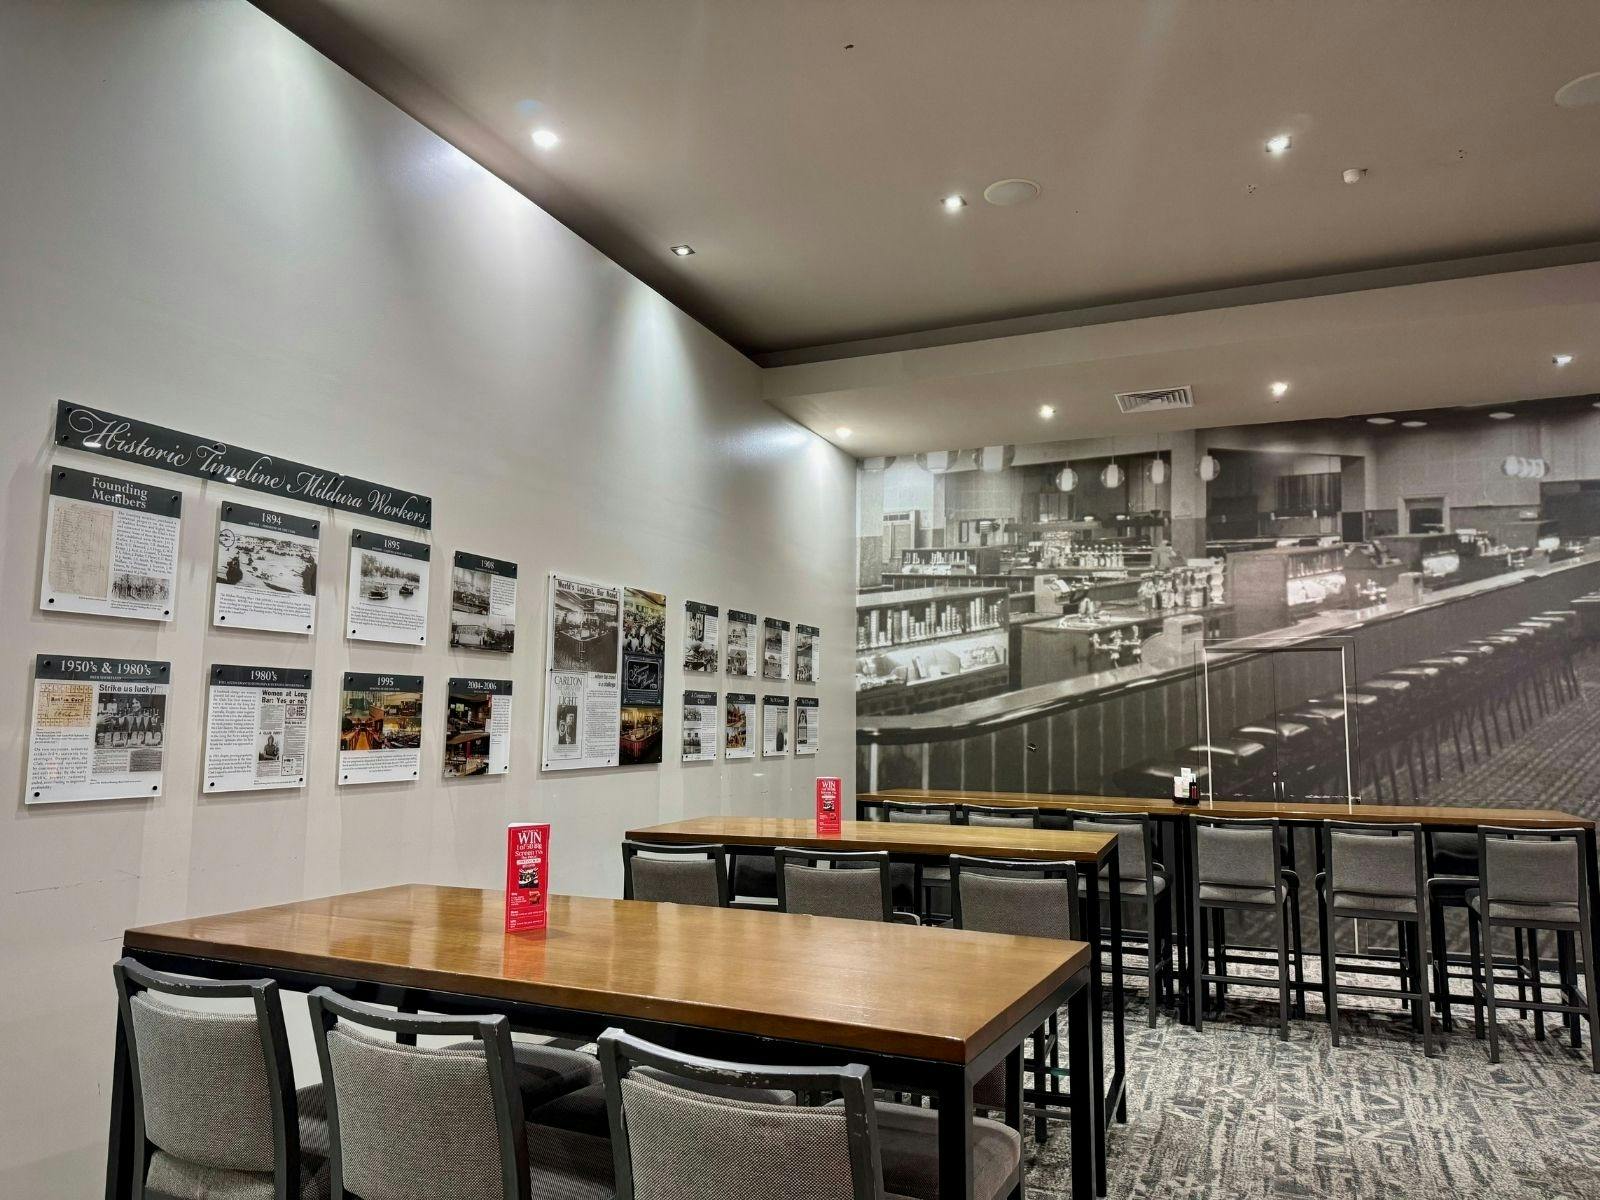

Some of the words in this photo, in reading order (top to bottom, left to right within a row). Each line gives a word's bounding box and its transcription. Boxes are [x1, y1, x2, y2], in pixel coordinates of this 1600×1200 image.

[69, 409, 192, 466] Historic
[196, 443, 285, 488] Timeline
[287, 472, 362, 508] Mildura
[92, 477, 148, 501] Founding
[92, 489, 147, 508] Members
[262, 512, 282, 525] 1894
[384, 540, 400, 550] 1895
[60, 660, 97, 672] 1950's
[102, 662, 112, 674] &
[117, 663, 151, 676] 1980's
[250, 670, 278, 681] 1980's
[377, 676, 394, 686] 1995
[554, 676, 582, 686] CARLTON
[99, 684, 122, 692] Strike
[134, 684, 157, 693] lucky!
[518, 831, 542, 844] WIN
